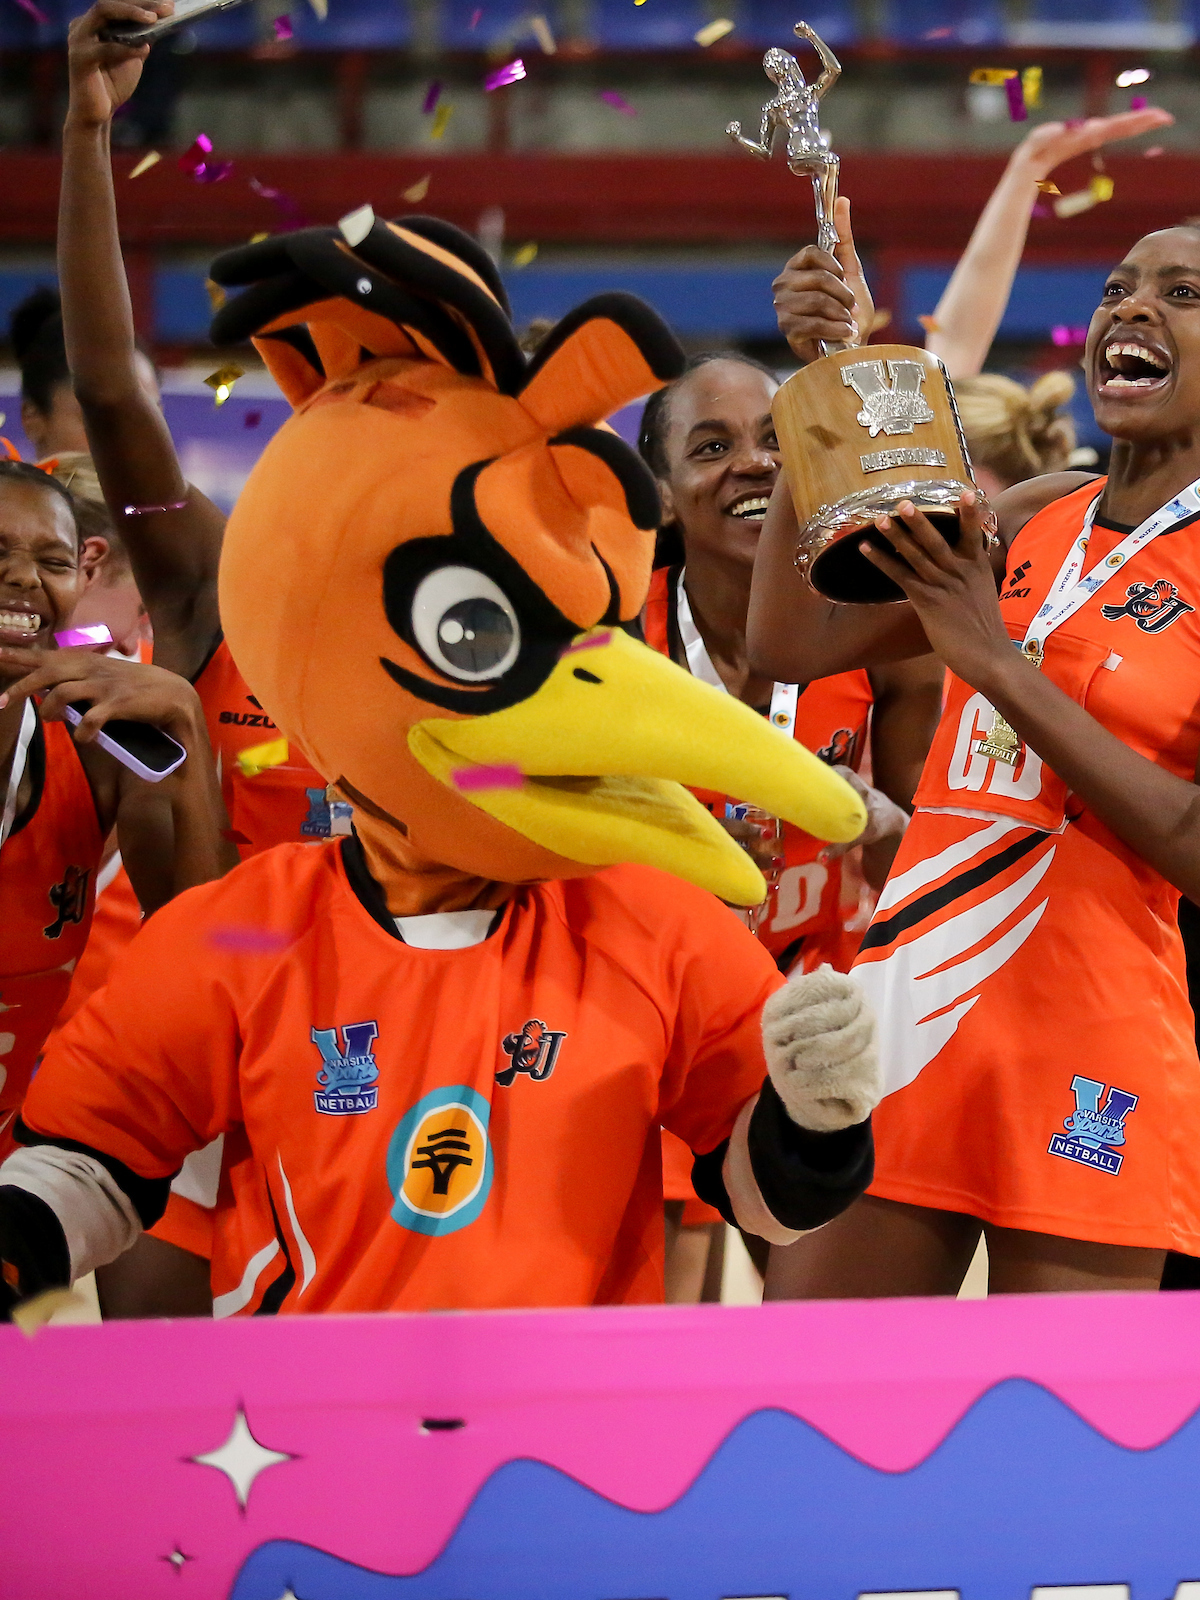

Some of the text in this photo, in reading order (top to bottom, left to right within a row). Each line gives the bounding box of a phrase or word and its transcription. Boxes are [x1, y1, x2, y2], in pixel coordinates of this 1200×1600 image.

[1138, 520, 1163, 540] SUZUKI
[1058, 568, 1075, 593] SUZUKI
[998, 587, 1032, 602] ZUKI
[219, 711, 277, 729] SUZU
[329, 1053, 376, 1068] VARSITY
[1063, 1108, 1127, 1146] Sports
[1083, 1108, 1126, 1130] VARSITY
[1054, 1140, 1115, 1169] NETBALL
